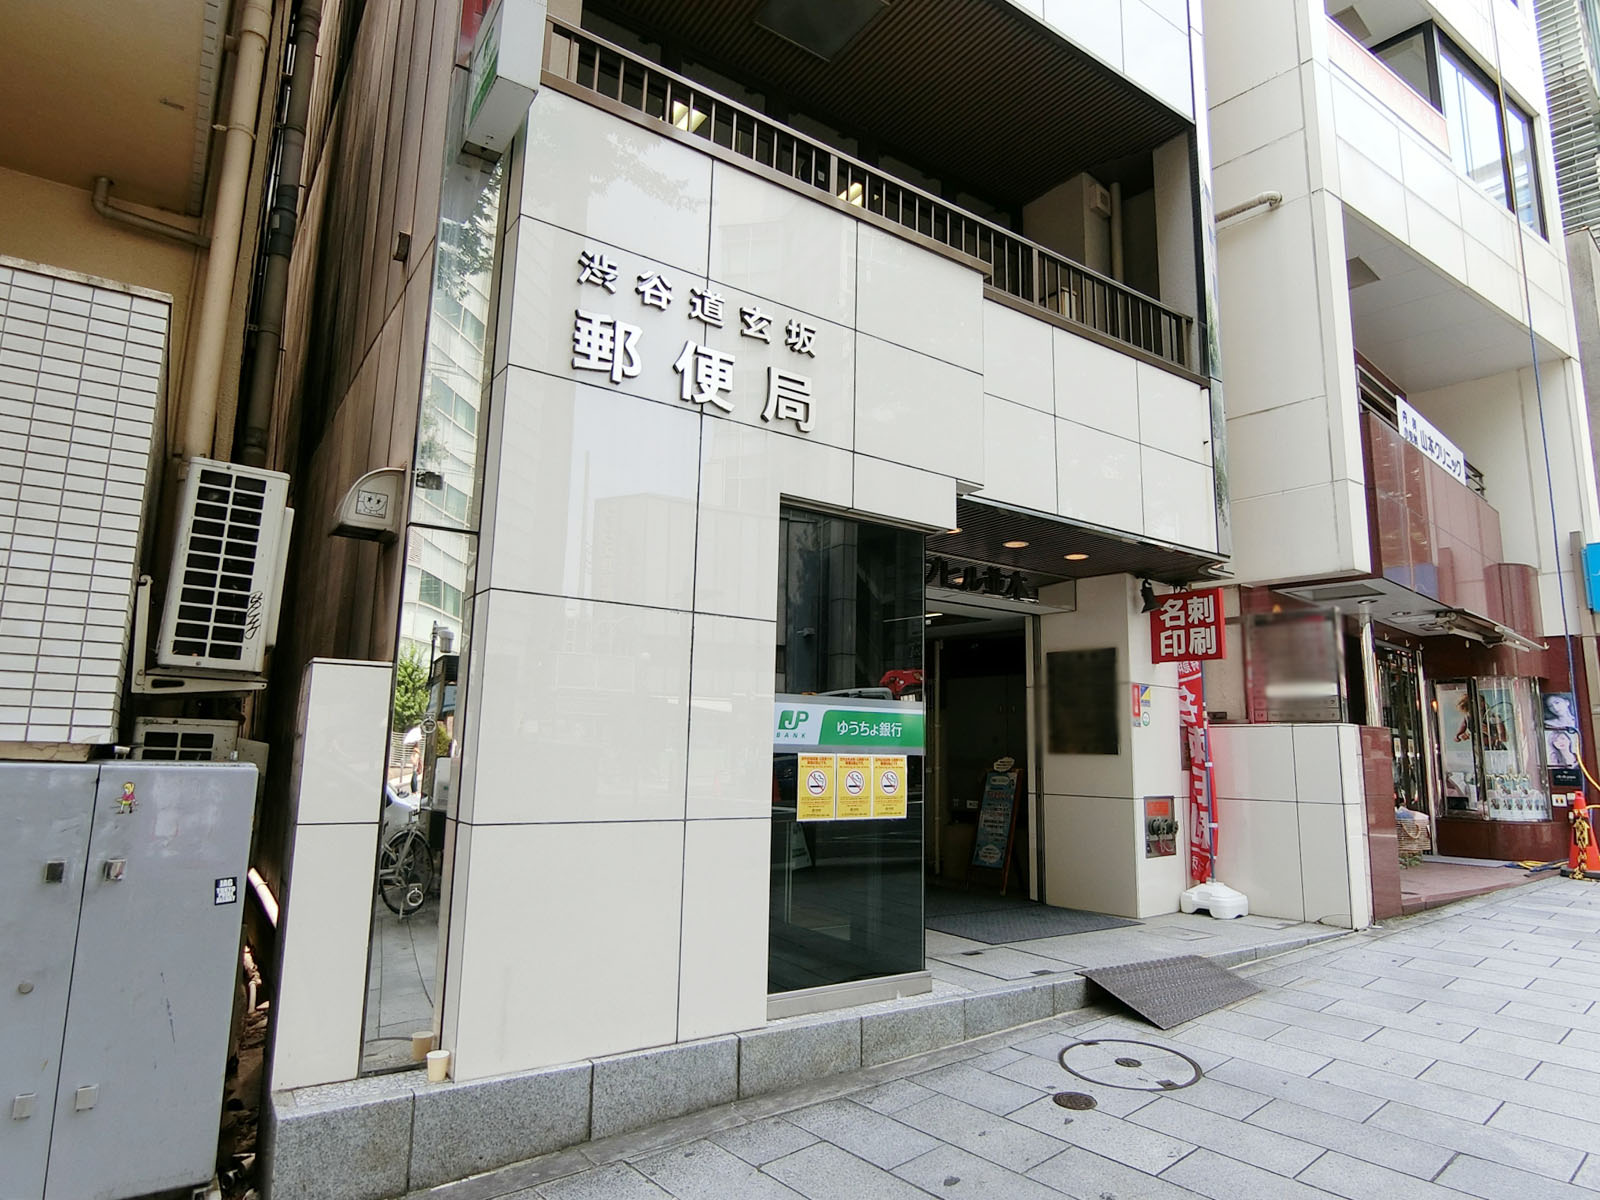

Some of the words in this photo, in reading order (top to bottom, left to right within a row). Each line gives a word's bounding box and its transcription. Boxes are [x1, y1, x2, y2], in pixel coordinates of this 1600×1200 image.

[577, 250, 817, 358] 渋谷道玄坂
[572, 309, 817, 433] 郵便局
[1159, 594, 1215, 628] 名刺
[1159, 625, 1217, 657] 印刷
[778, 710, 809, 730] JP
[836, 720, 903, 738] ゆうちょ銀行
